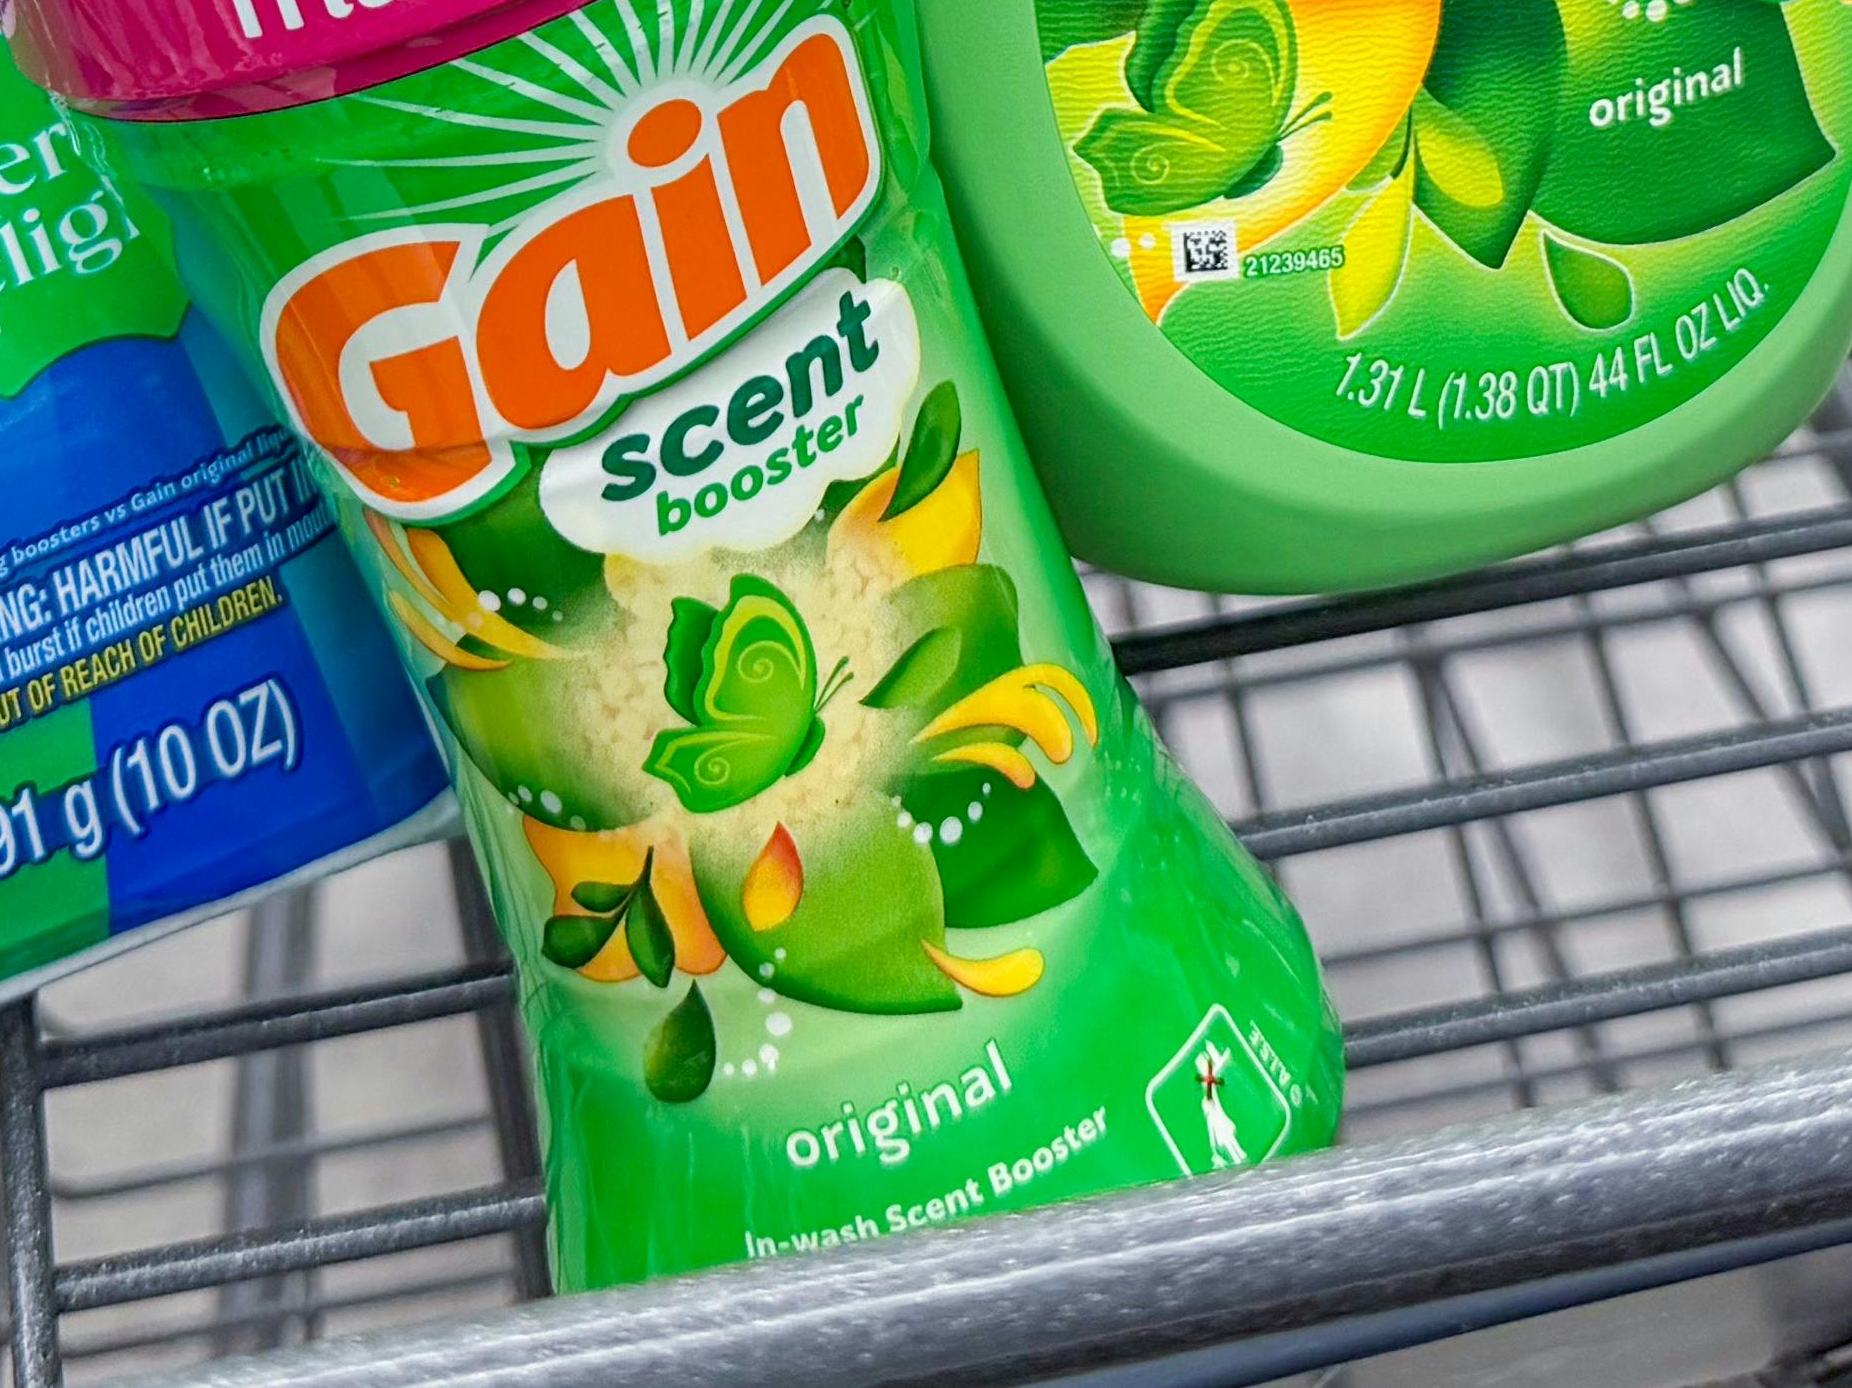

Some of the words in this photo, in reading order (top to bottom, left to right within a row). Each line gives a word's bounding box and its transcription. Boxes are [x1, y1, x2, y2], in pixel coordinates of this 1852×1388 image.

[1589, 47, 1745, 126] original
[271, 31, 873, 504] Gain
[1245, 244, 1345, 278] 21239465
[601, 290, 880, 502] scent
[1335, 352, 1404, 411] 1.31
[1407, 368, 1428, 419] L
[1437, 370, 1517, 430] (1.38
[1526, 361, 1580, 418] QT)
[1589, 353, 1629, 398] 44
[1634, 331, 1674, 384] FL
[1675, 301, 1718, 361] OZ
[1714, 267, 1770, 333] LIQ.
[11, 515, 101, 568] boosters
[104, 503, 128, 524] vs
[130, 482, 177, 513] Gain
[180, 441, 254, 485] original
[656, 394, 864, 537] booster
[4, 626, 66, 679] burst
[64, 615, 84, 652] if
[85, 585, 171, 643] children
[173, 568, 211, 609] put
[210, 544, 263, 586] them
[264, 530, 285, 564] in
[53, 516, 204, 616] HARMFUL
[203, 496, 232, 551] IF
[235, 469, 290, 535] PUT
[26, 673, 56, 713] OF
[60, 637, 136, 700] REACH
[138, 624, 167, 664] OF
[170, 575, 284, 650] CHILDREN.
[63, 779, 104, 859] g
[111, 724, 198, 835] (10
[206, 678, 297, 772] OZ)
[785, 1039, 1013, 1169] original
[744, 1214, 880, 1259] In-wash
[884, 1177, 985, 1233] Scent
[989, 1105, 1110, 1197] Booster
